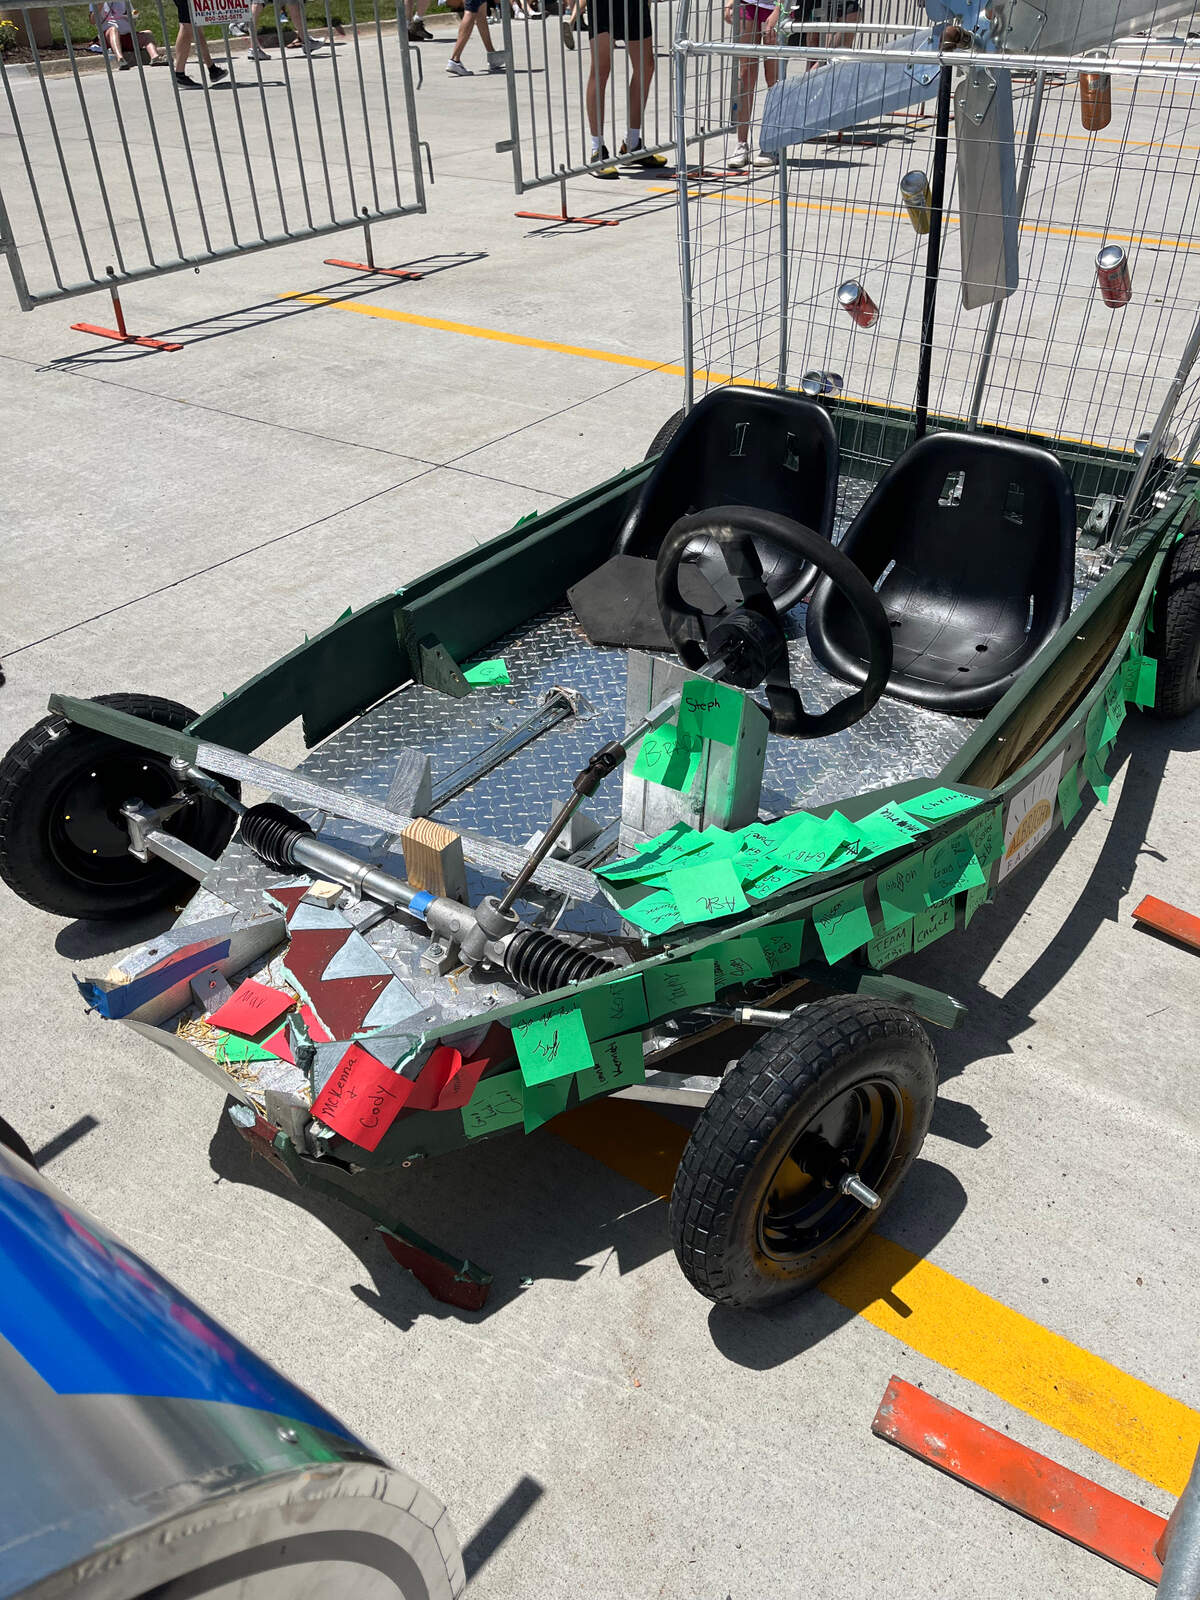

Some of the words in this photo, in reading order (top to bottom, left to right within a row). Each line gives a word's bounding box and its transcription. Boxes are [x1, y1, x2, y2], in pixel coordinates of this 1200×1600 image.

[194, 0, 248, 12] NATIONAL
[685, 697, 721, 713] Steph
[360, 1083, 398, 1129] Cody
